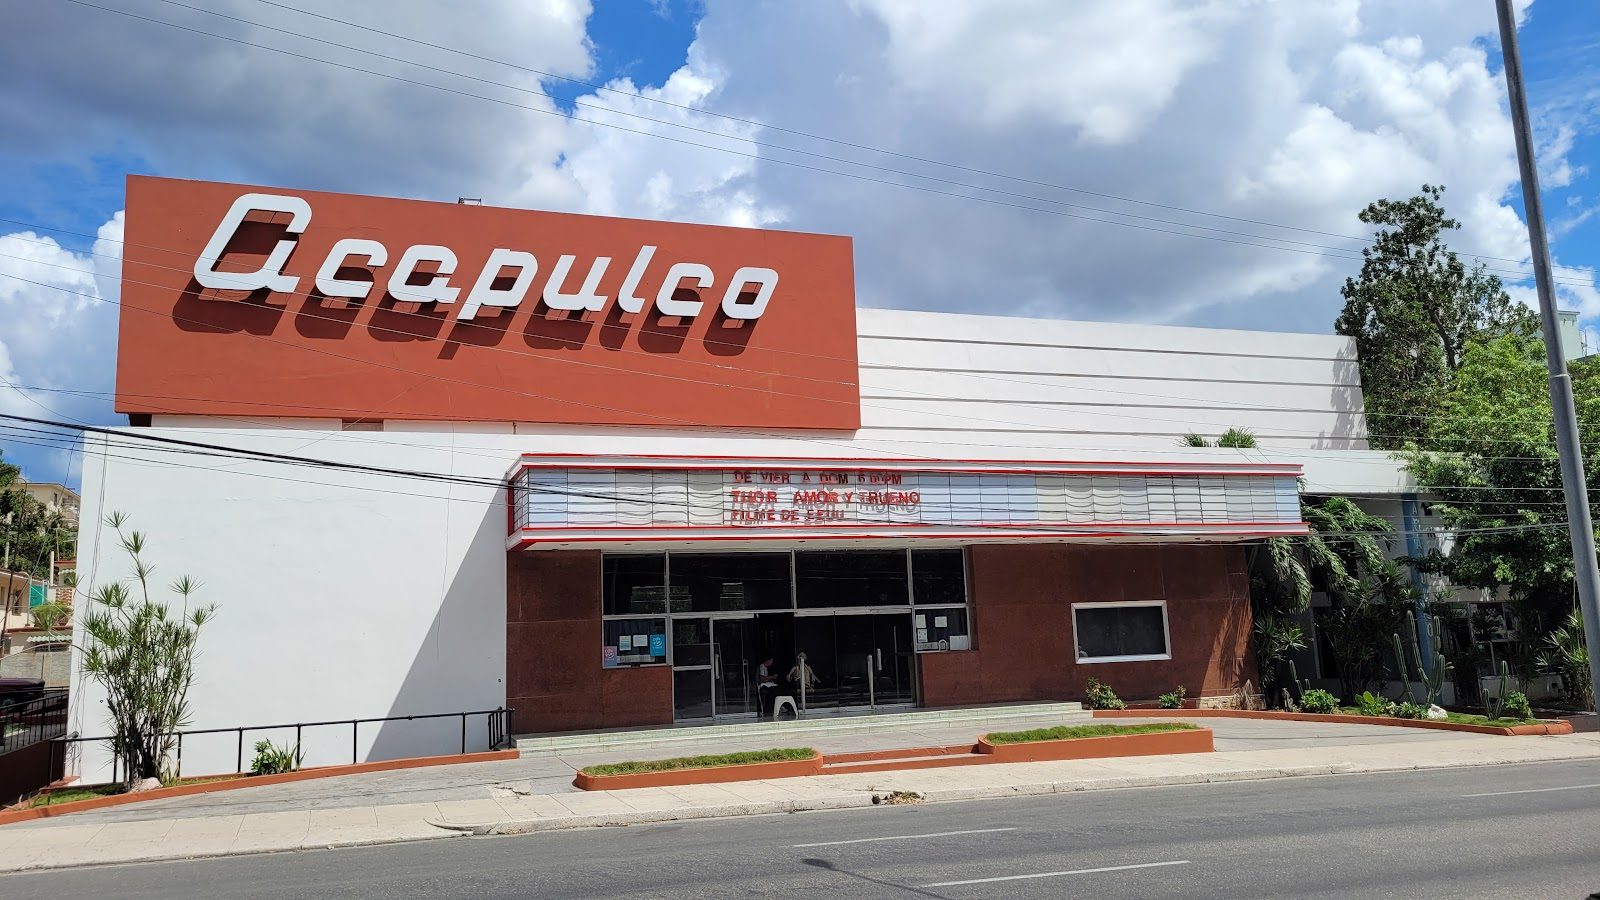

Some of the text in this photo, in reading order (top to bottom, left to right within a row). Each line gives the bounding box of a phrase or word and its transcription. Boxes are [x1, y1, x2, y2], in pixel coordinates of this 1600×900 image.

[734, 471, 753, 483] DE
[761, 471, 790, 483] VIER
[803, 472, 811, 482] A
[819, 472, 849, 484] DOM
[731, 490, 920, 505] THOR AMOR Y TRUENO
[731, 509, 776, 521] FILME
[781, 510, 800, 521] DE
